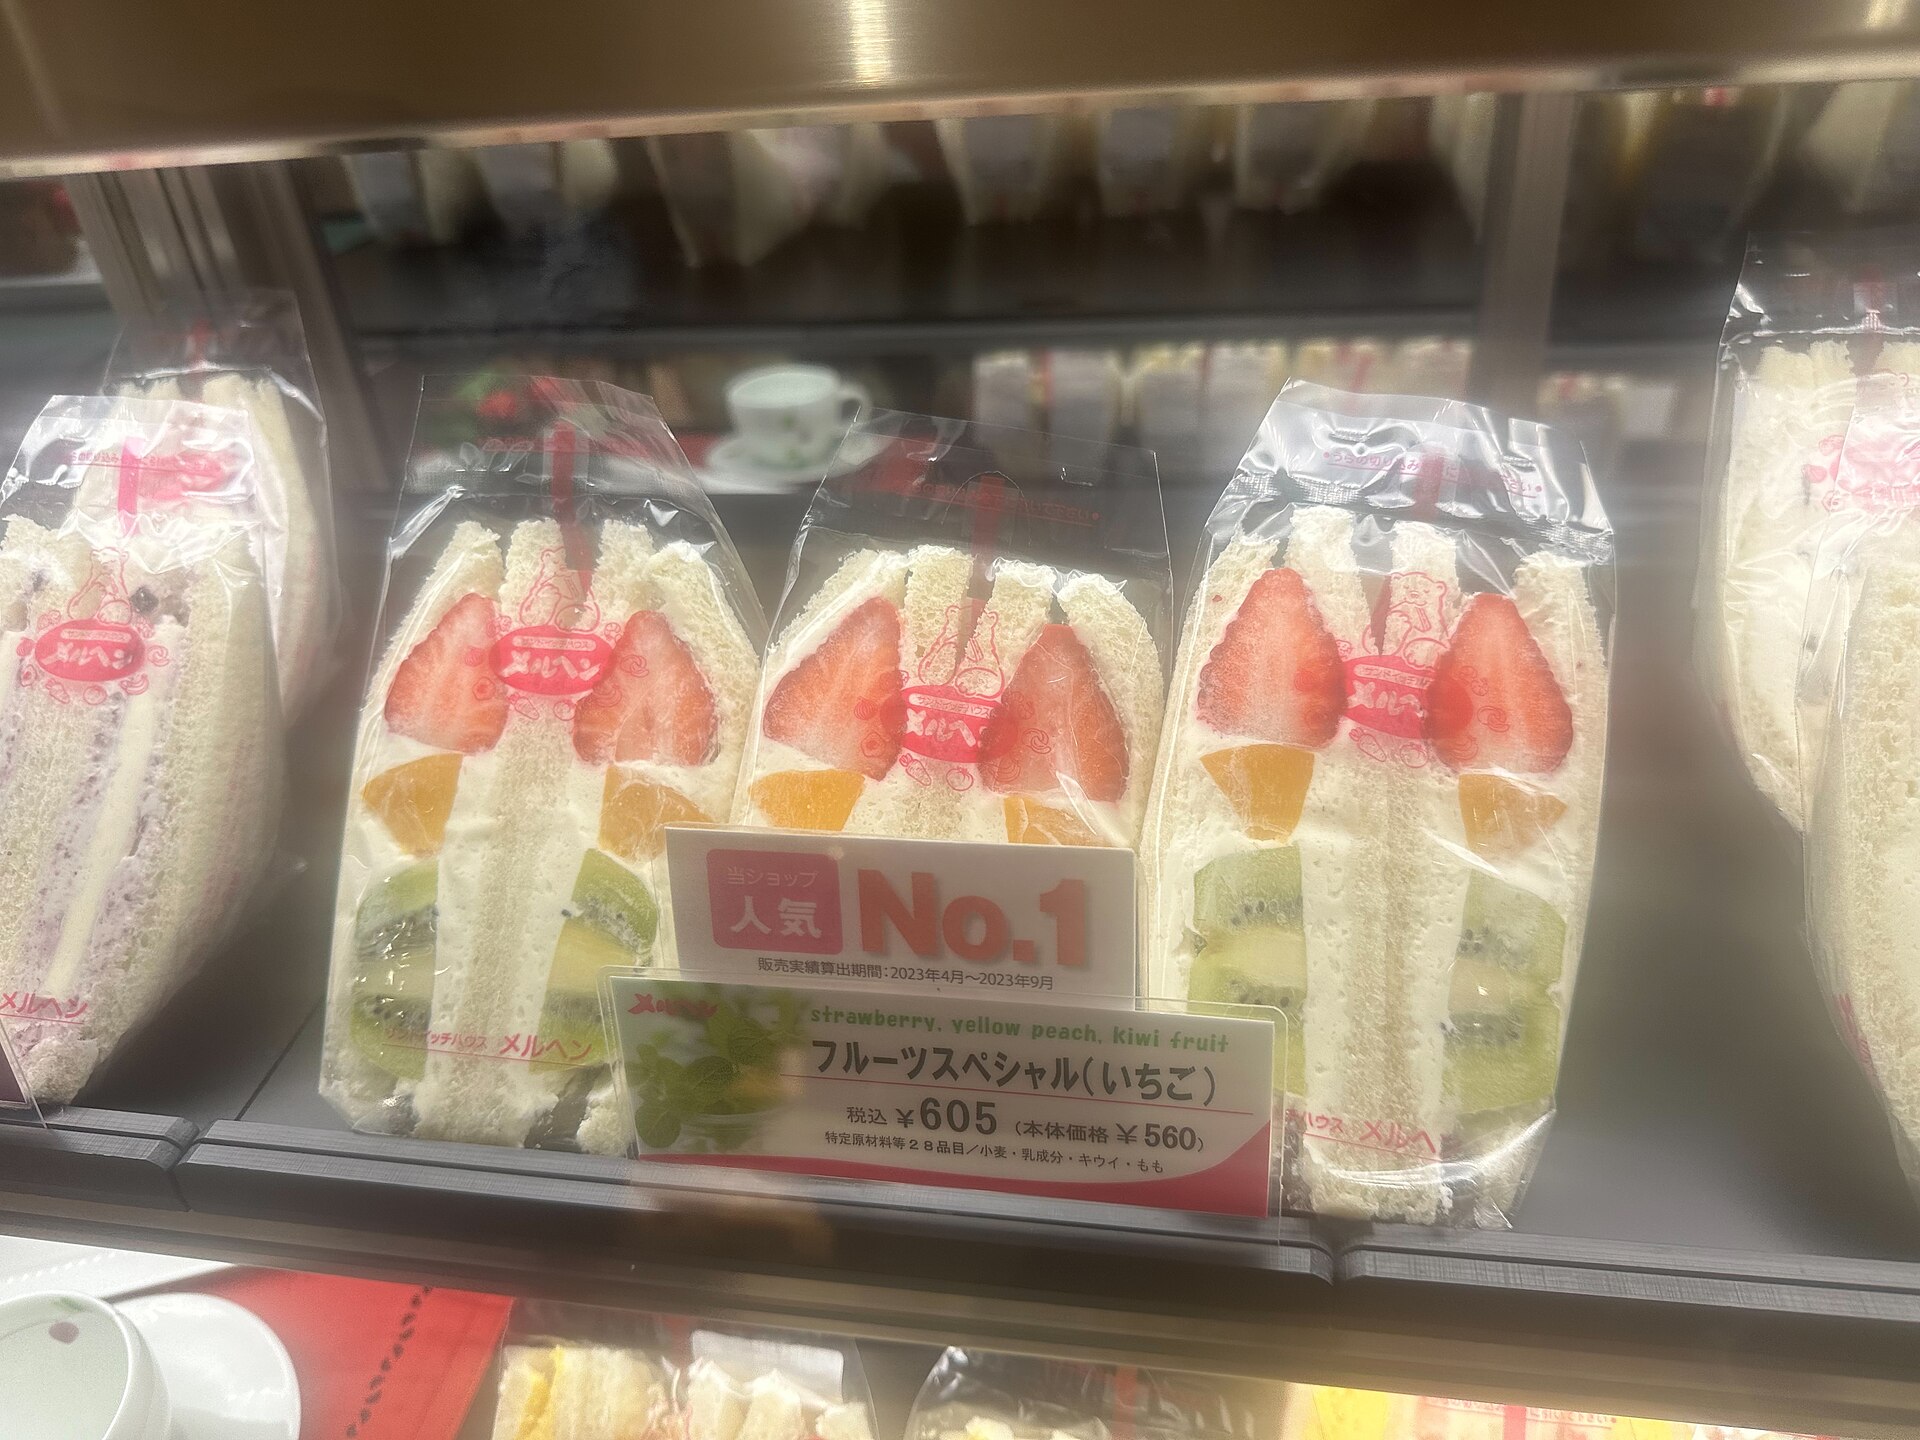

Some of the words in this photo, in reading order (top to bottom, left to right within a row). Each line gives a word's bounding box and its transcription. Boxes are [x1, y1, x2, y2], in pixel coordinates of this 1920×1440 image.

[726, 866, 818, 888] 当ショップ
[730, 896, 822, 939] 人気
[857, 868, 1086, 966] No.1
[499, 1033, 592, 1061] メルヘン
[952, 1016, 1022, 1036] yellow
[1031, 1022, 1103, 1045] peach,
[1112, 1026, 1160, 1048] kiwi
[1169, 1031, 1230, 1053] fruit
[811, 1039, 1217, 1107] フルーツスペシャル(いちご)
[846, 1105, 888, 1126] 税込
[895, 1096, 998, 1136] ¥605
